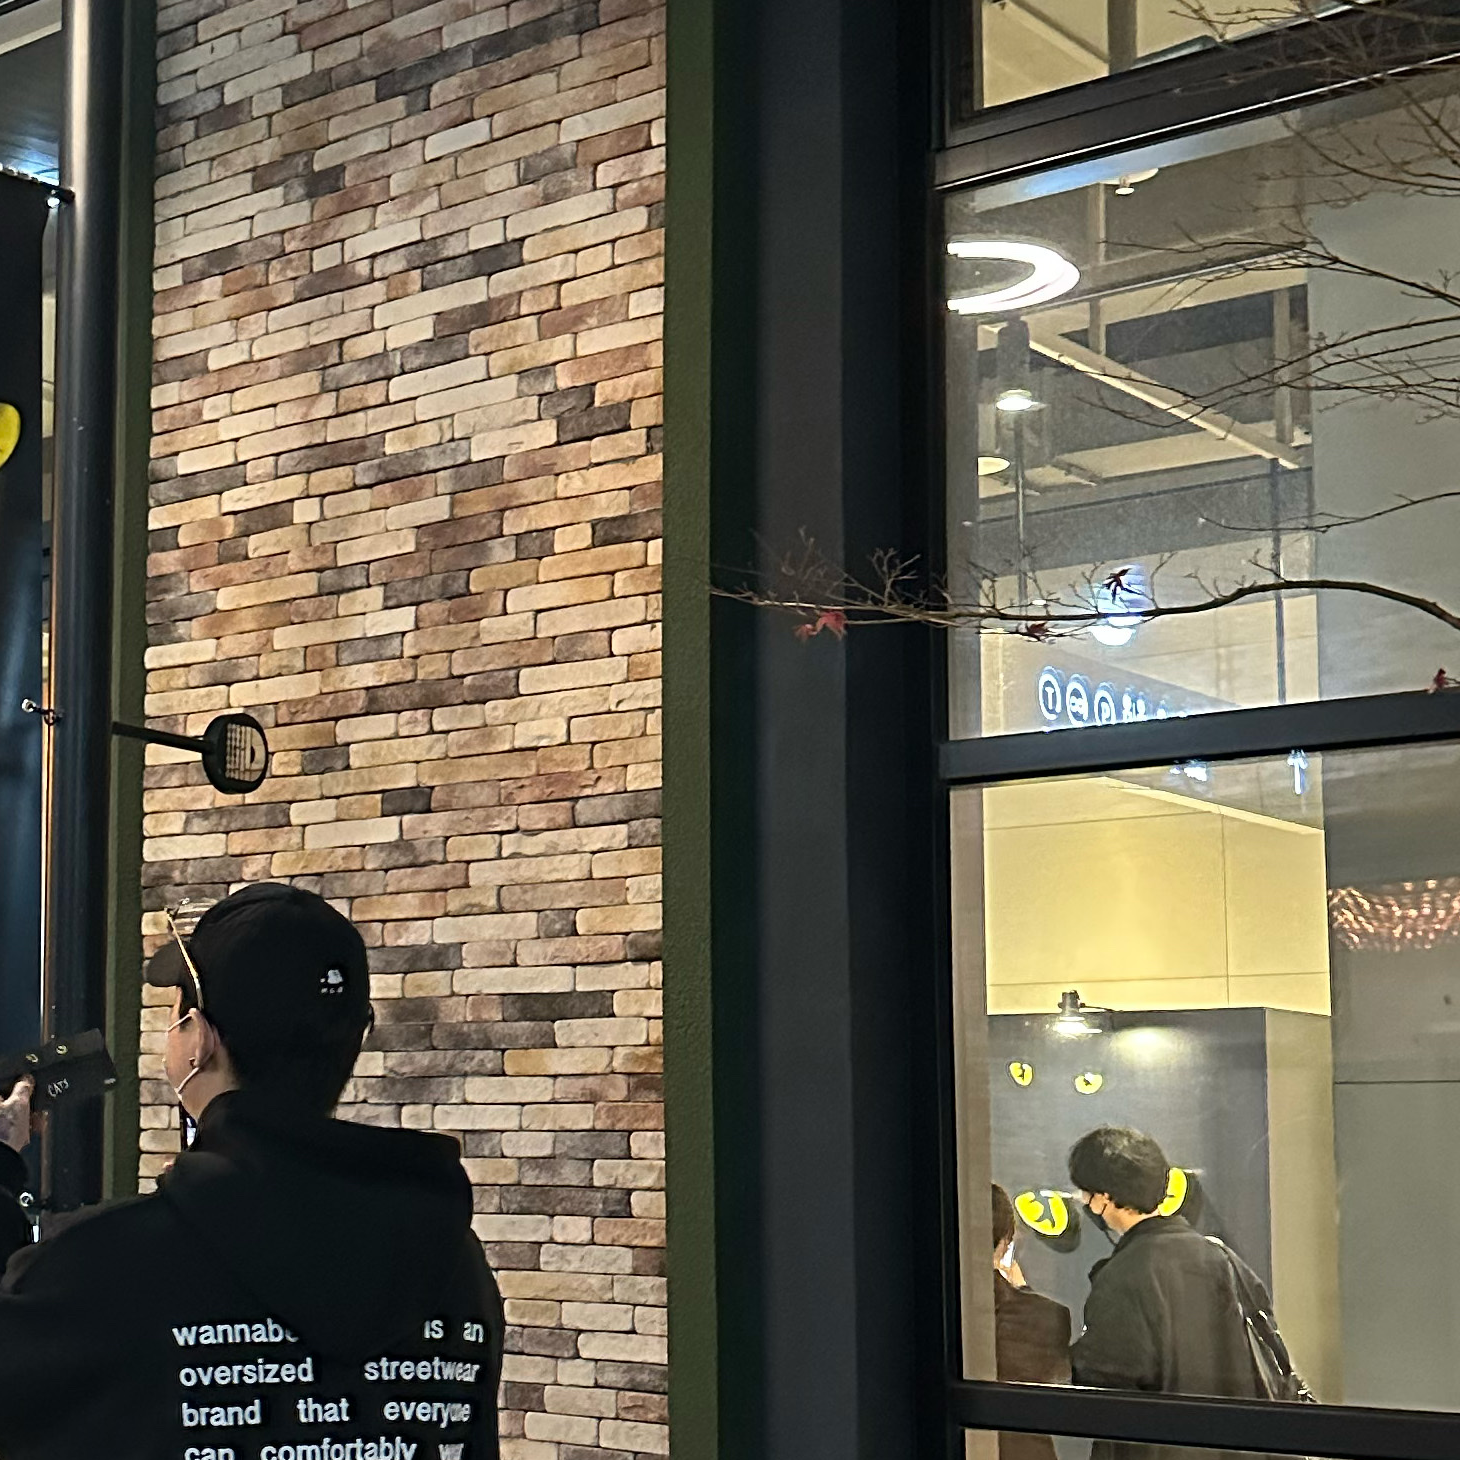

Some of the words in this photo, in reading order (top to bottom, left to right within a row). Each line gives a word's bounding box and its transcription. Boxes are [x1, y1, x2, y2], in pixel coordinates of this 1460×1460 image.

[462, 1321, 484, 1344] an
[179, 1356, 314, 1387] oversized
[364, 1356, 481, 1383] streetwear
[181, 1399, 261, 1427] brand
[296, 1397, 350, 1423] that
